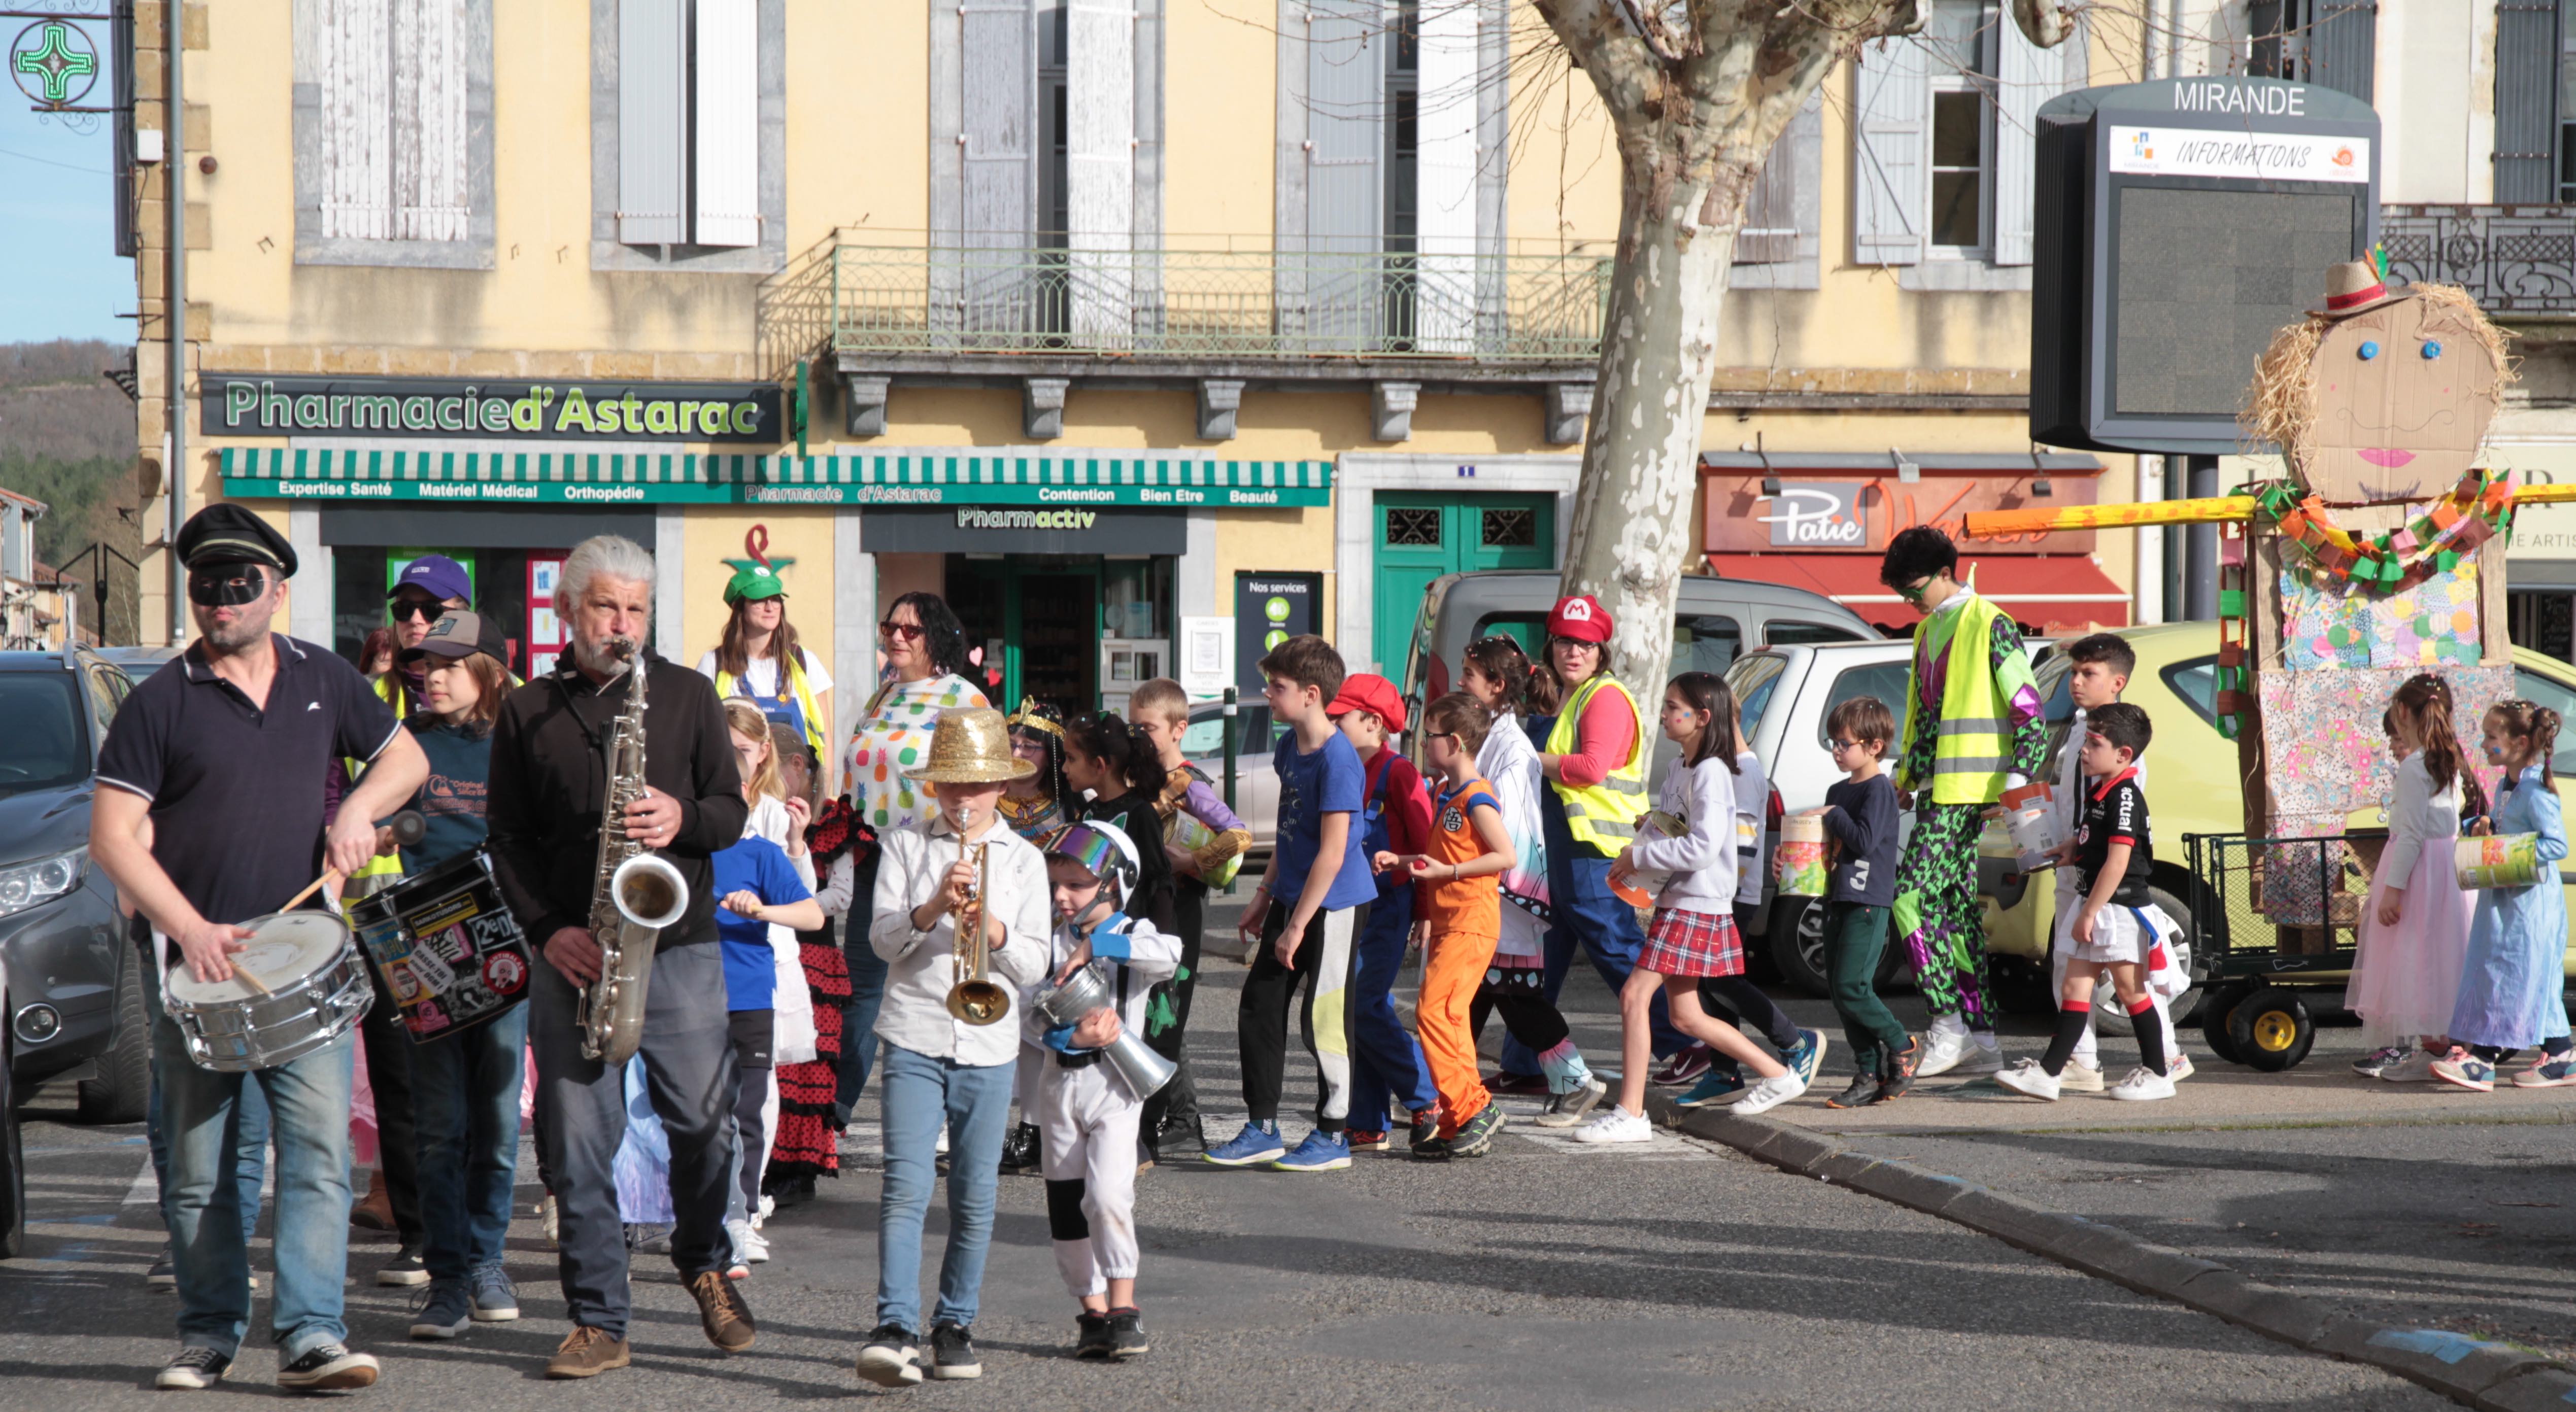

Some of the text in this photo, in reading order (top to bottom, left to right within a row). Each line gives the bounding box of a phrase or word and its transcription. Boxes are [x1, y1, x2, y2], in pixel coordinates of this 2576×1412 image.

[2175, 81, 2305, 116] MIRANDE
[2177, 140, 2312, 168] INFORMATIONS
[279, 481, 392, 497] Expertise Santé
[419, 483, 538, 499] Matériel Médical
[564, 485, 645, 502] Orthopédie
[744, 485, 942, 502] Pharmacie d'Astarac
[1038, 487, 1115, 501] Contention
[1140, 488, 1204, 503] Bien Etre
[1229, 490, 1278, 504] Beauté
[957, 505, 1096, 529] Pharmactiv
[1756, 489, 1862, 542] Patie
[1249, 582, 1307, 594] Nos services
[1567, 603, 1586, 616] M
[2118, 786, 2134, 833] actual
[1850, 859, 1870, 891] 3
